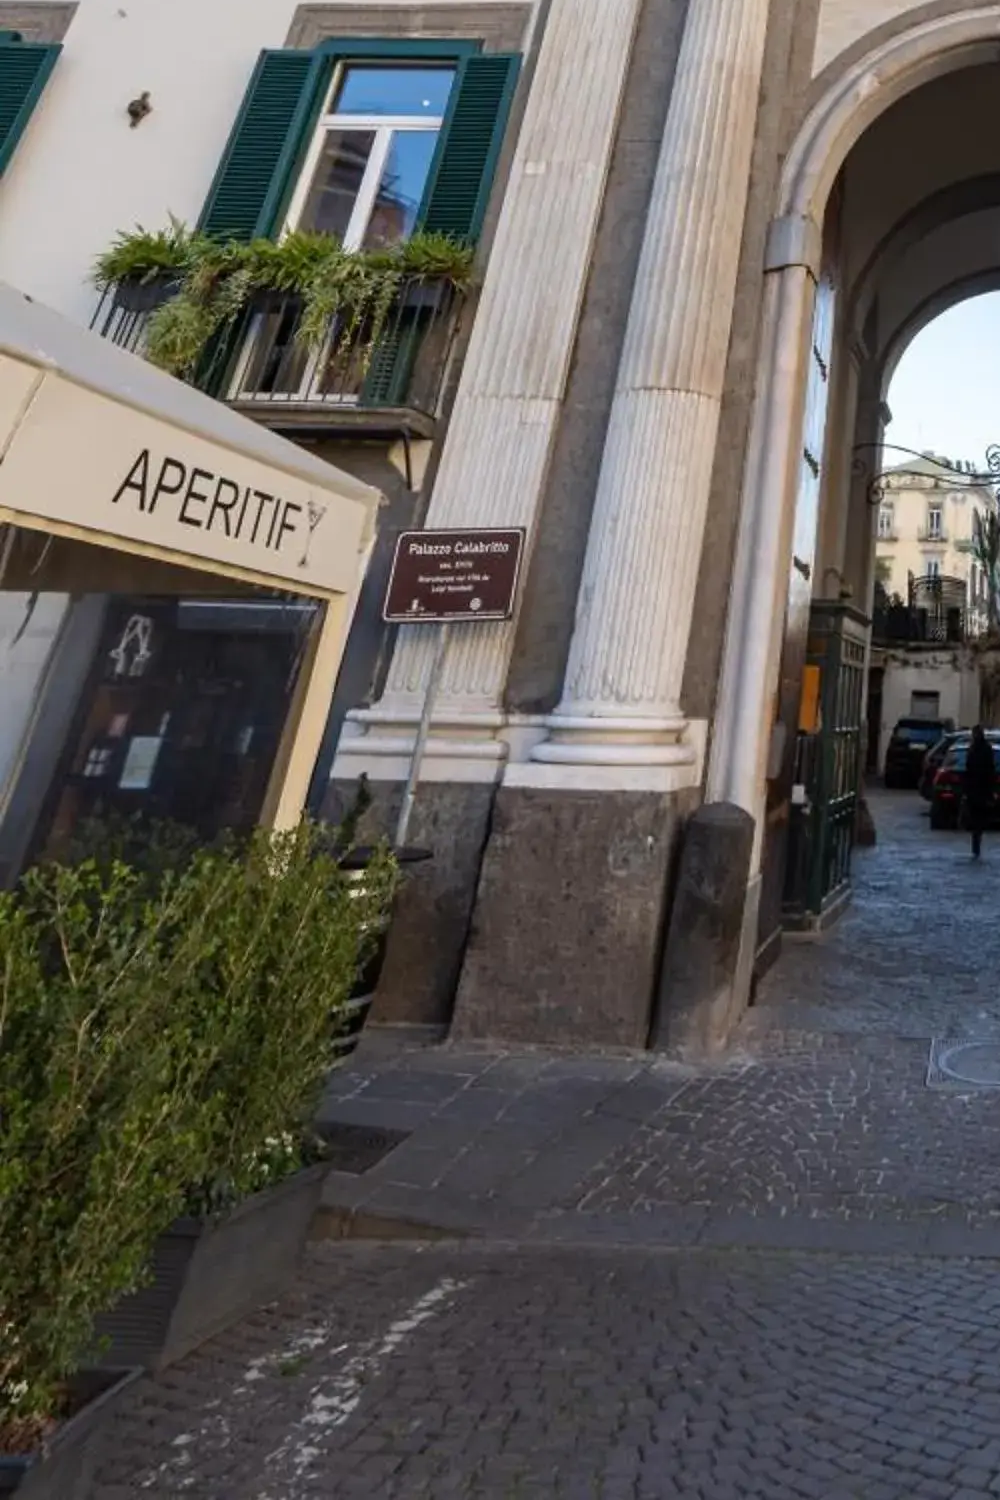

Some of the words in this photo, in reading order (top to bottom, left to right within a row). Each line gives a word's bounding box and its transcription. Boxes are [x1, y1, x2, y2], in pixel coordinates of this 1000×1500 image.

[111, 448, 302, 551] APERITIF
[409, 543, 452, 555] Palazzo
[454, 541, 509, 554] Calabritto
